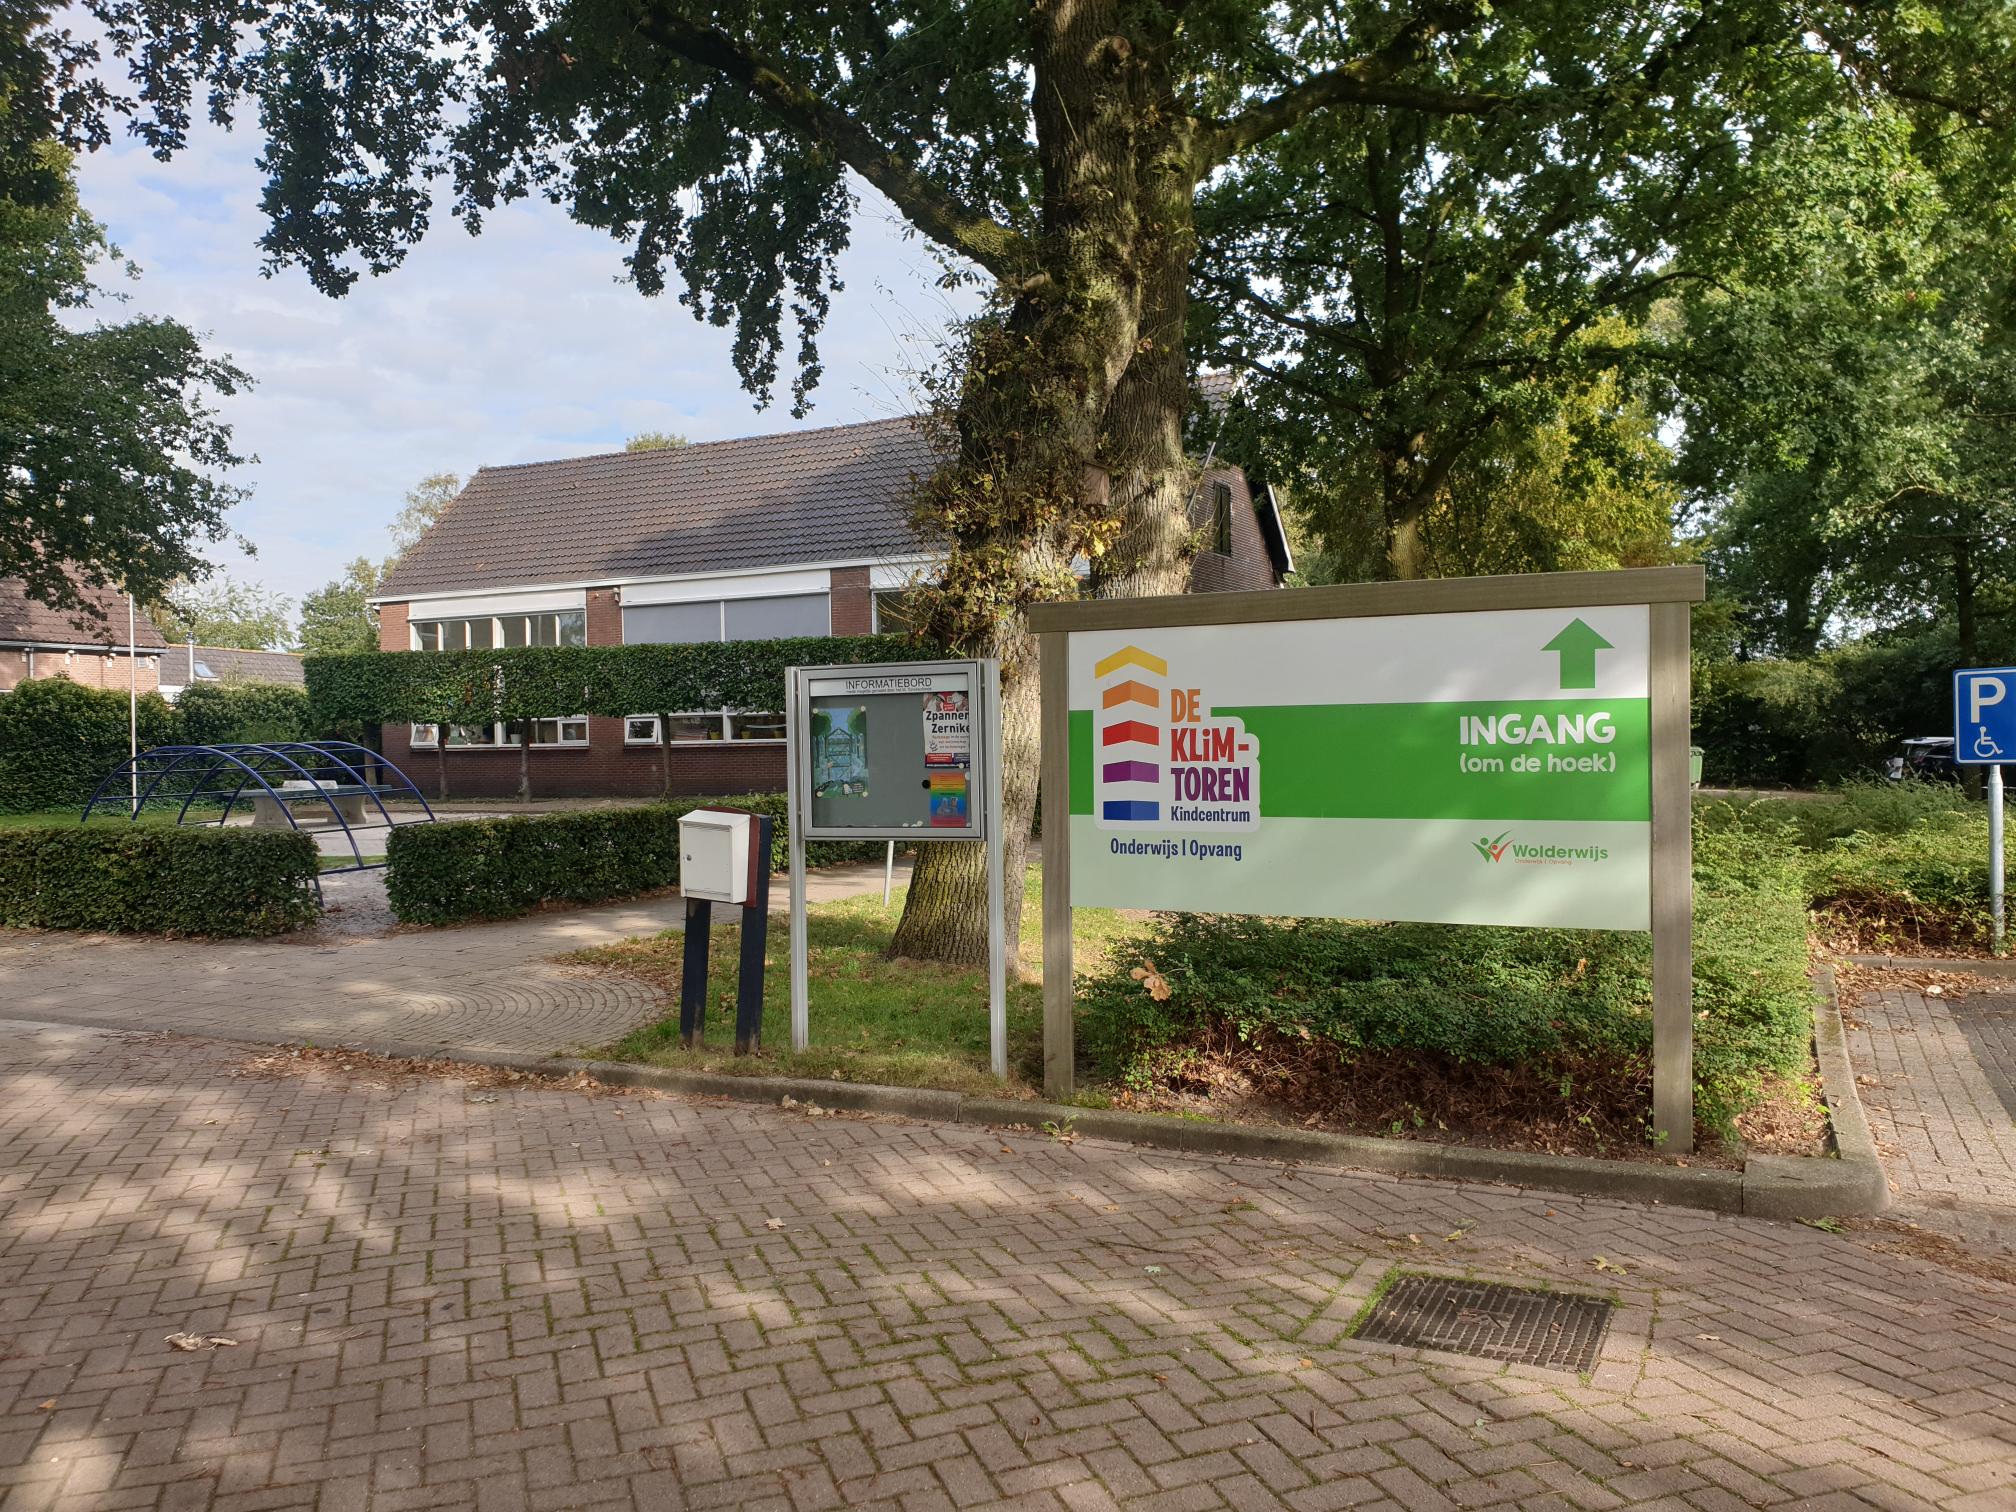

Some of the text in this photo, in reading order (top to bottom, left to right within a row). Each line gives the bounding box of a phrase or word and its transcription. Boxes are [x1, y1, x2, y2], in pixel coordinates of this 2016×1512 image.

[846, 677, 932, 690] INFORMATIEBORD
[1170, 688, 1201, 723] DE
[1970, 677, 2006, 724] P
[1459, 712, 1616, 746] INGANG
[1459, 751, 1616, 774] (om de hoek)
[1170, 766, 1250, 802] TOREN
[1170, 805, 1251, 823] Kindcentrum
[1110, 837, 1179, 860] Onderwijs
[1189, 839, 1242, 862] Opvang
[1512, 844, 1609, 863] Wolderwijs
